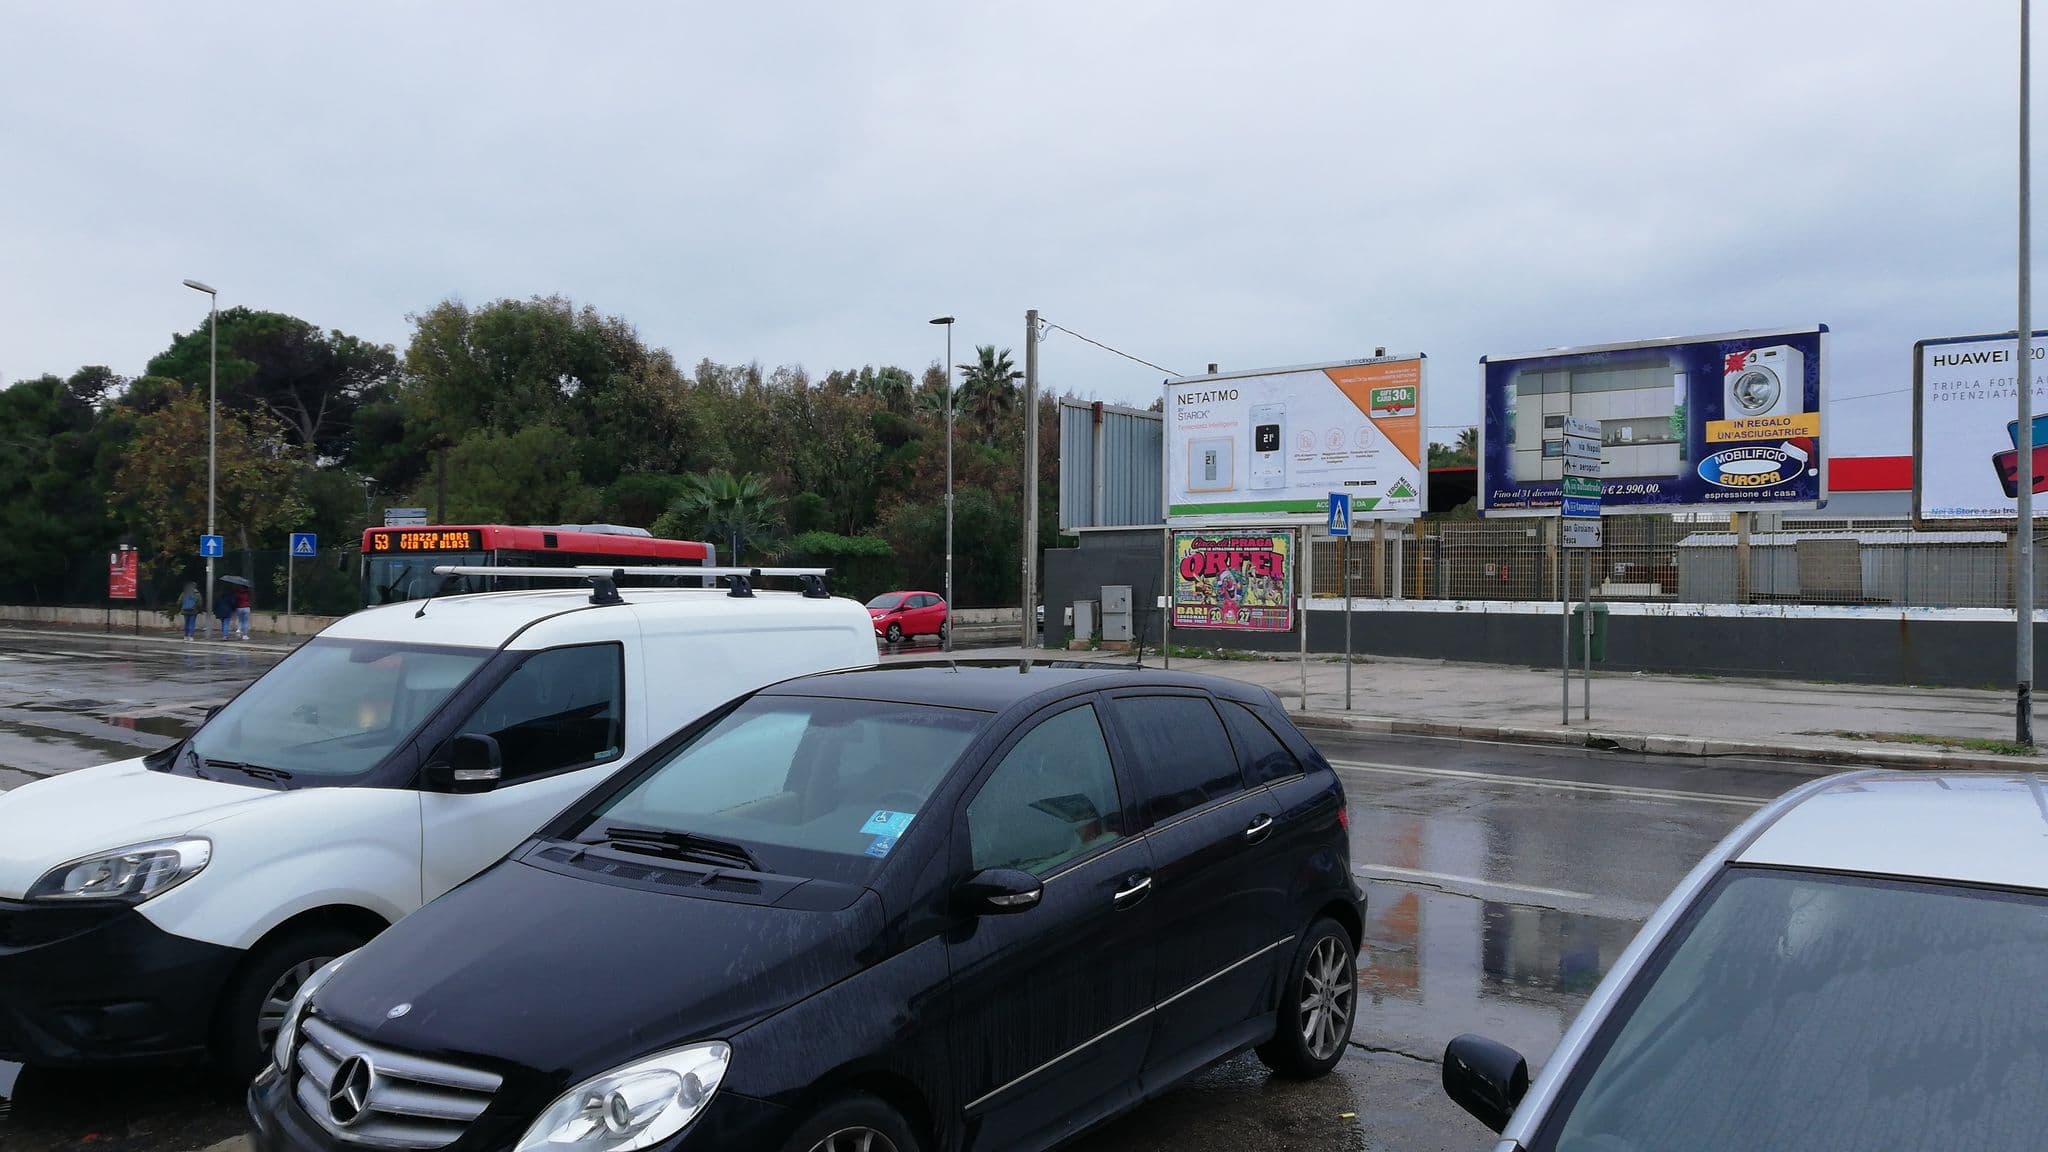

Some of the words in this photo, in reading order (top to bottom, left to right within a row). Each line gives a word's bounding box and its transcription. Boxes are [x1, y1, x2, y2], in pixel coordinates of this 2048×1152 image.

[1933, 350, 2009, 367] HUAWEI
[1933, 380, 1981, 391] TRIPLA
[1177, 389, 1239, 405] NETATMO
[1933, 388, 2017, 402] POTENZIATA
[1734, 421, 1744, 429] IN
[1747, 418, 1791, 428] REGALO
[1717, 427, 1809, 440] UN'ASCIUGATRICE
[1714, 449, 1787, 464] MOBILIFICIO
[1719, 471, 1781, 486] EUROPA
[1532, 487, 1563, 497] dicembr
[1704, 491, 1759, 500] espressione
[1762, 489, 1771, 498] di
[1774, 490, 1796, 498] casa
[374, 533, 389, 550] 53
[400, 533, 438, 541] PIAZZA
[442, 532, 469, 540] MORO
[400, 541, 419, 549] VIA
[423, 541, 436, 549] DE
[440, 540, 470, 549] BLASI
[1181, 551, 1283, 579] ORFEI
[1177, 607, 1208, 615] BARI
[1210, 610, 1222, 621] 20
[1239, 611, 1250, 622] 27
